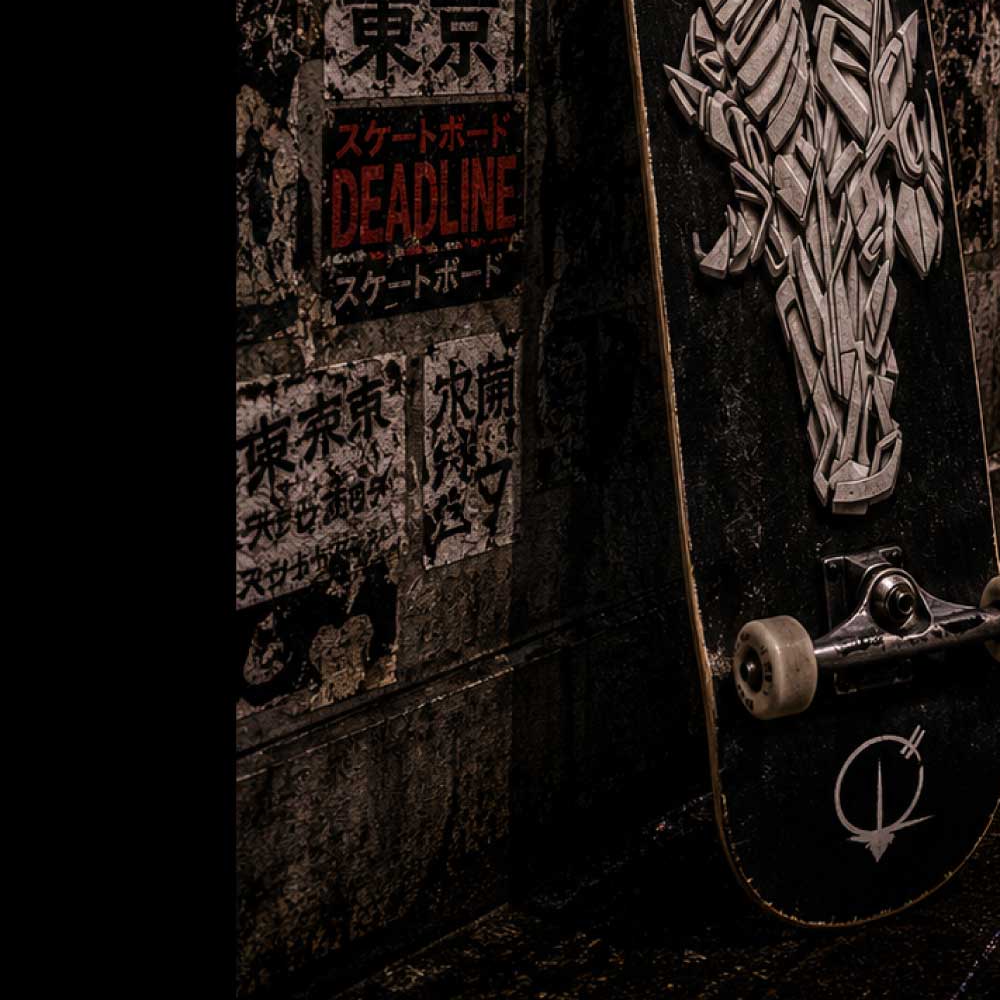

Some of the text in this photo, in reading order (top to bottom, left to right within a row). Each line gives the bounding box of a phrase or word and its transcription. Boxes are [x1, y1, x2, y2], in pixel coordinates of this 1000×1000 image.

[335, 111, 511, 161] スケートボード
[330, 153, 517, 250] DEADLINE
